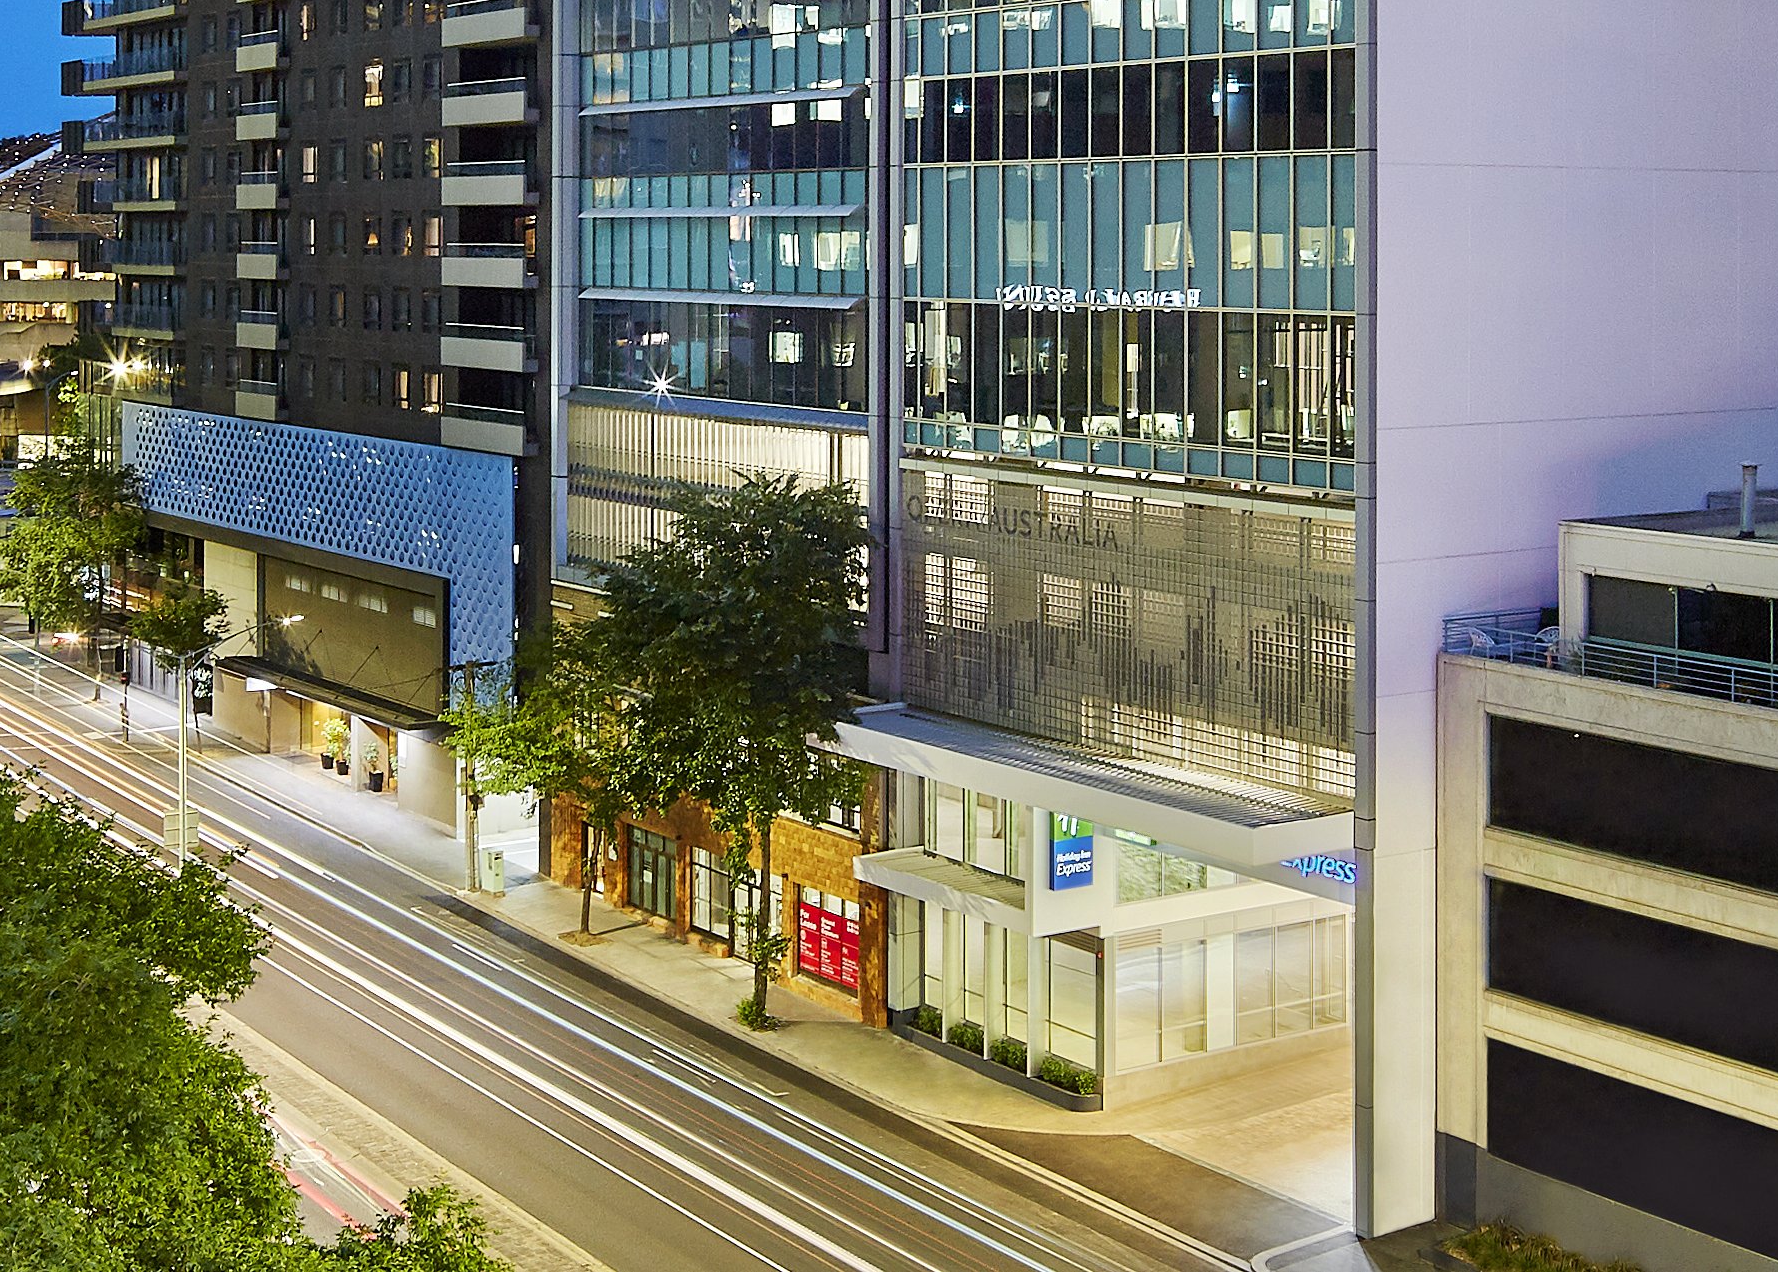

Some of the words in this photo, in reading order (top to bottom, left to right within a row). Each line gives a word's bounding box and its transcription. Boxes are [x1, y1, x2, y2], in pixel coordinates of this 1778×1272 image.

[987, 506, 1119, 552] AUSTRALIA
[1056, 860, 1093, 877] Express
[1279, 854, 1358, 884] xpress
